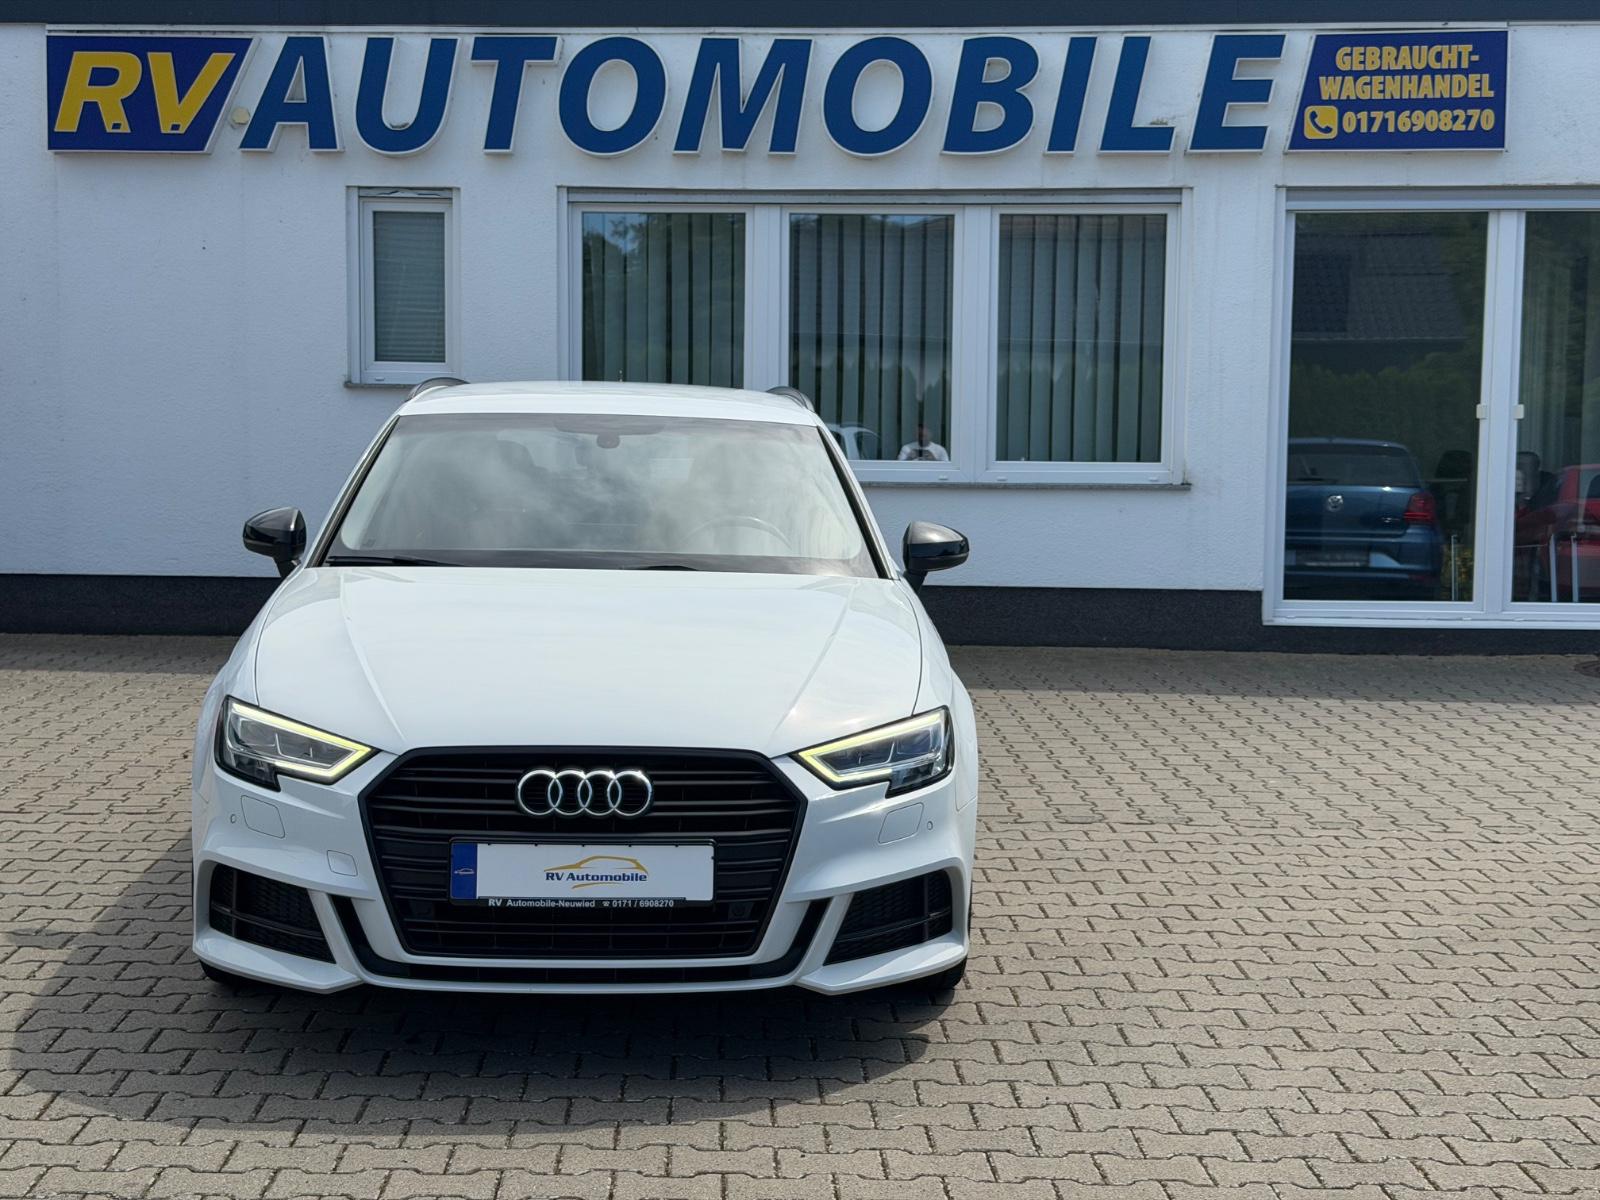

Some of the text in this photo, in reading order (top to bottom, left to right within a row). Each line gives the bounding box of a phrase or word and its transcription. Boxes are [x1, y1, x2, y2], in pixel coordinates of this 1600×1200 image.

[1335, 45, 1480, 71] GEBRAUCHT-
[54, 34, 1286, 156] RV AUTOMOBILE
[1319, 74, 1495, 100] WAGENHANDEL
[1342, 109, 1495, 133] 01716908270
[545, 872, 647, 882] RV Automobile
[488, 899, 503, 908] RV
[506, 899, 596, 909] Automobile-Neuwied
